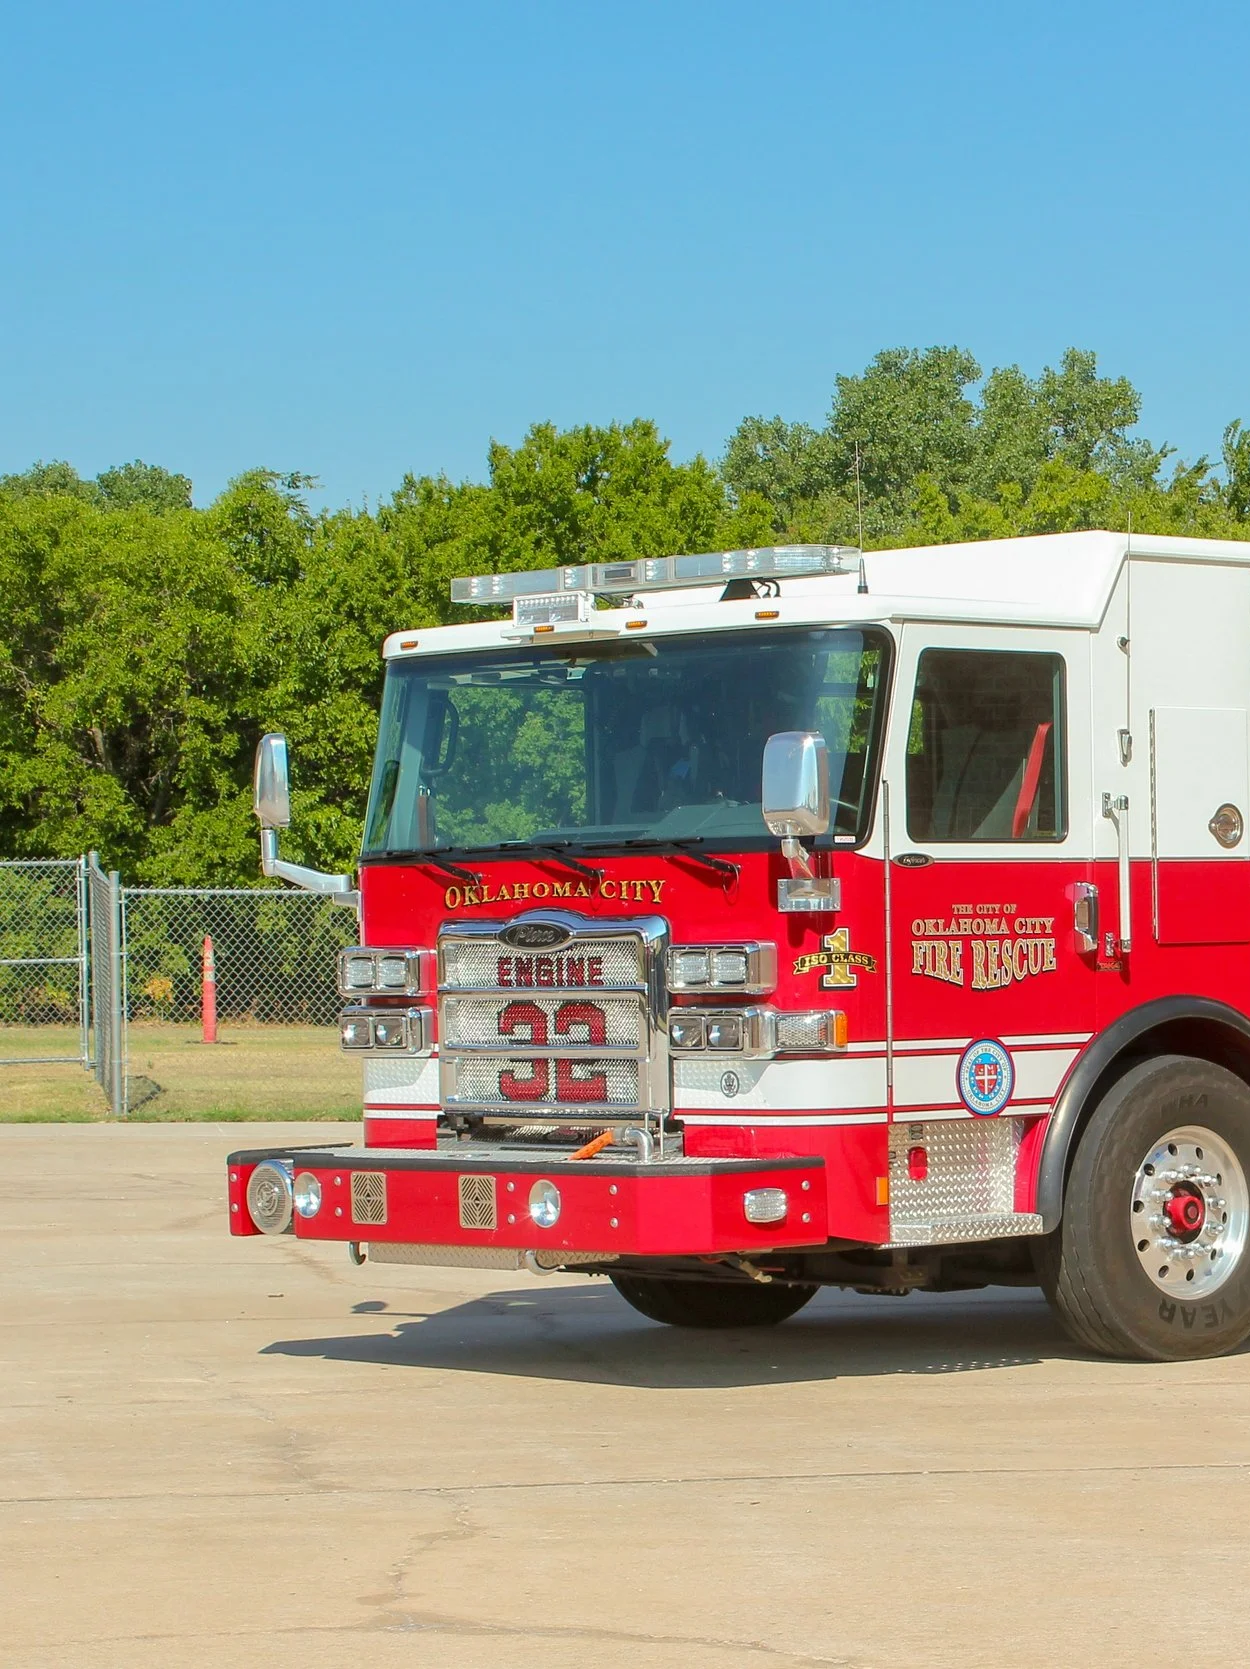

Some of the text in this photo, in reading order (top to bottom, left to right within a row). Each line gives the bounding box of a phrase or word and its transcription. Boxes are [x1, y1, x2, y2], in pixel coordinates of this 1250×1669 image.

[444, 880, 666, 909] OKLAHOMA CITY
[952, 904, 1017, 914] THE CITY OF
[911, 917, 1055, 936] OKLAHOMA CITY
[498, 957, 604, 987] ENGINE
[804, 953, 869, 967] ISO CLASS
[911, 938, 1057, 990] FIRE RESCUE
[498, 1000, 606, 1101] 32
